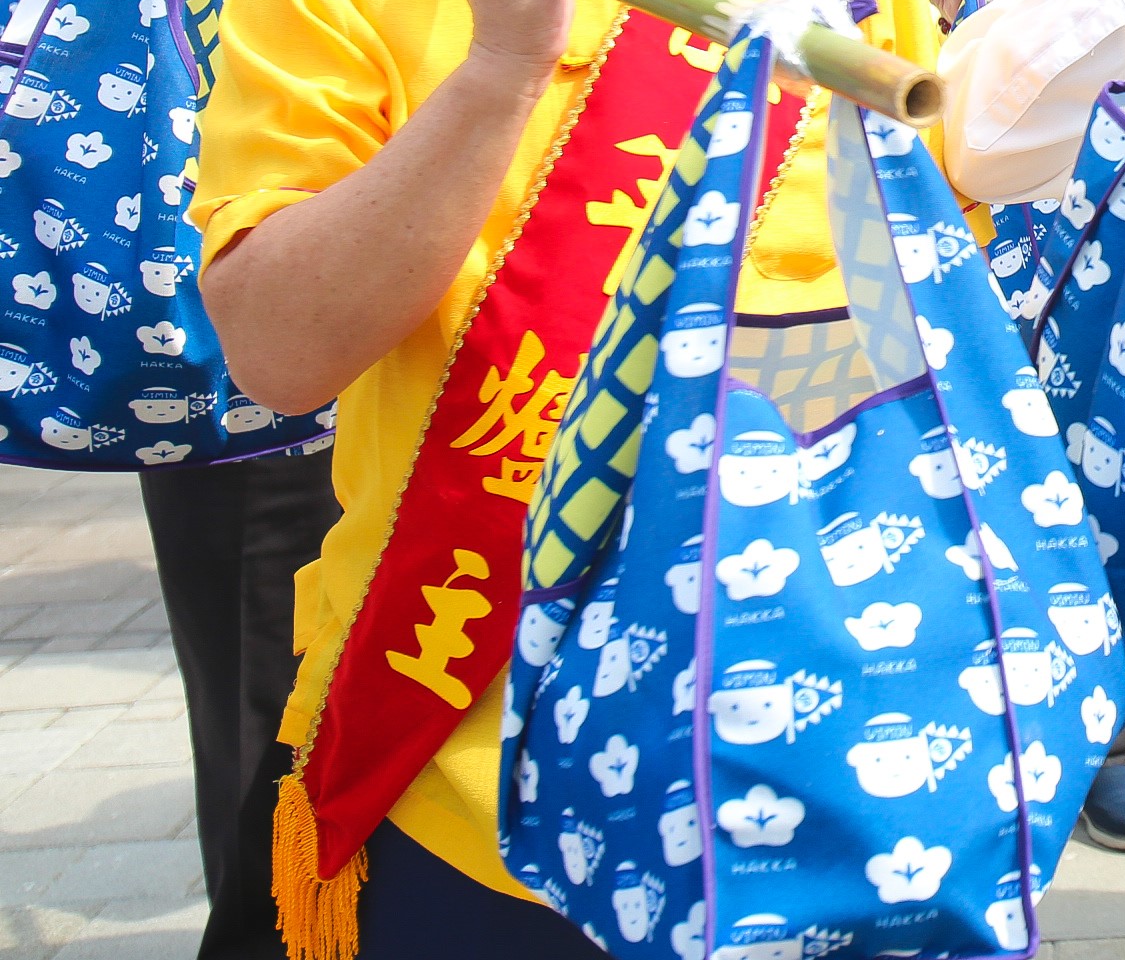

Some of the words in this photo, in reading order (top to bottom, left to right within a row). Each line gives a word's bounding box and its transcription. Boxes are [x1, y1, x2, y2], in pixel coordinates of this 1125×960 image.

[132, 31, 150, 44] HAK
[38, 42, 70, 58] AKKA
[21, 76, 48, 91] IMIN
[53, 166, 87, 185] HAKKA
[103, 230, 131, 248] HAKKA
[152, 253, 174, 262] YIM
[4, 310, 46, 327] HAKKA
[0, 348, 26, 363] IMIN
[140, 361, 183, 369] HAKKA
[66, 373, 90, 392] HAKKA
